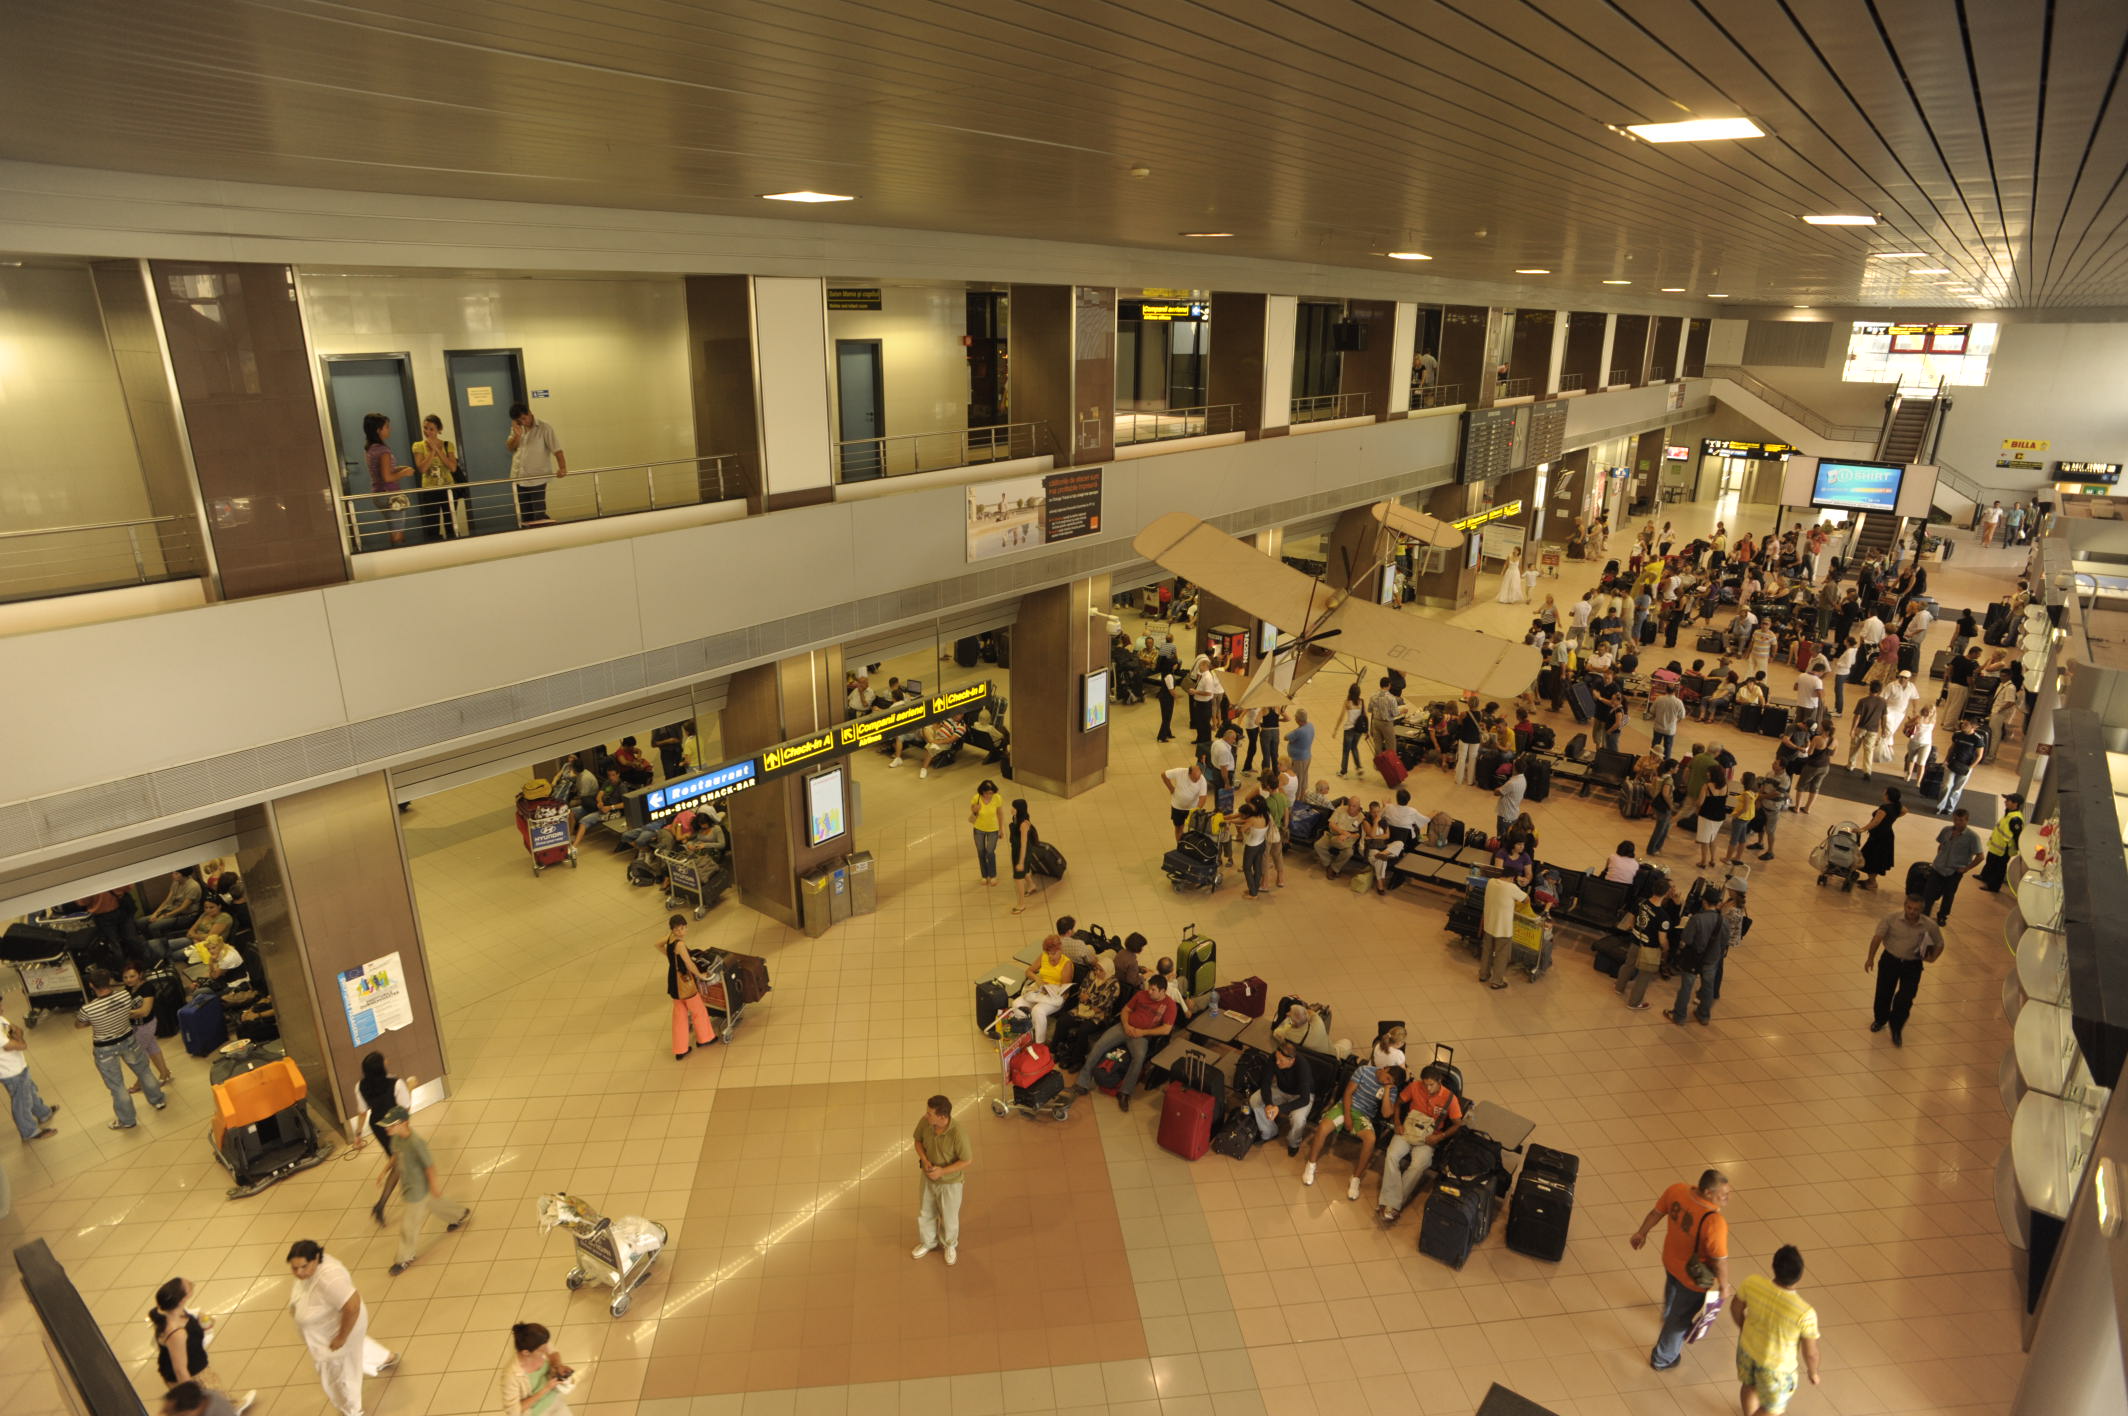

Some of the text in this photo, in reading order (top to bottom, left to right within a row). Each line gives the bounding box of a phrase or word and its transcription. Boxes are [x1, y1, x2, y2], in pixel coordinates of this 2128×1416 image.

[2011, 441, 2037, 449] BILLA
[858, 705, 925, 735] Companii aeriene
[823, 735, 831, 746] A
[671, 765, 750, 800] Restaurant
[700, 778, 756, 804] SNACK-BAR
